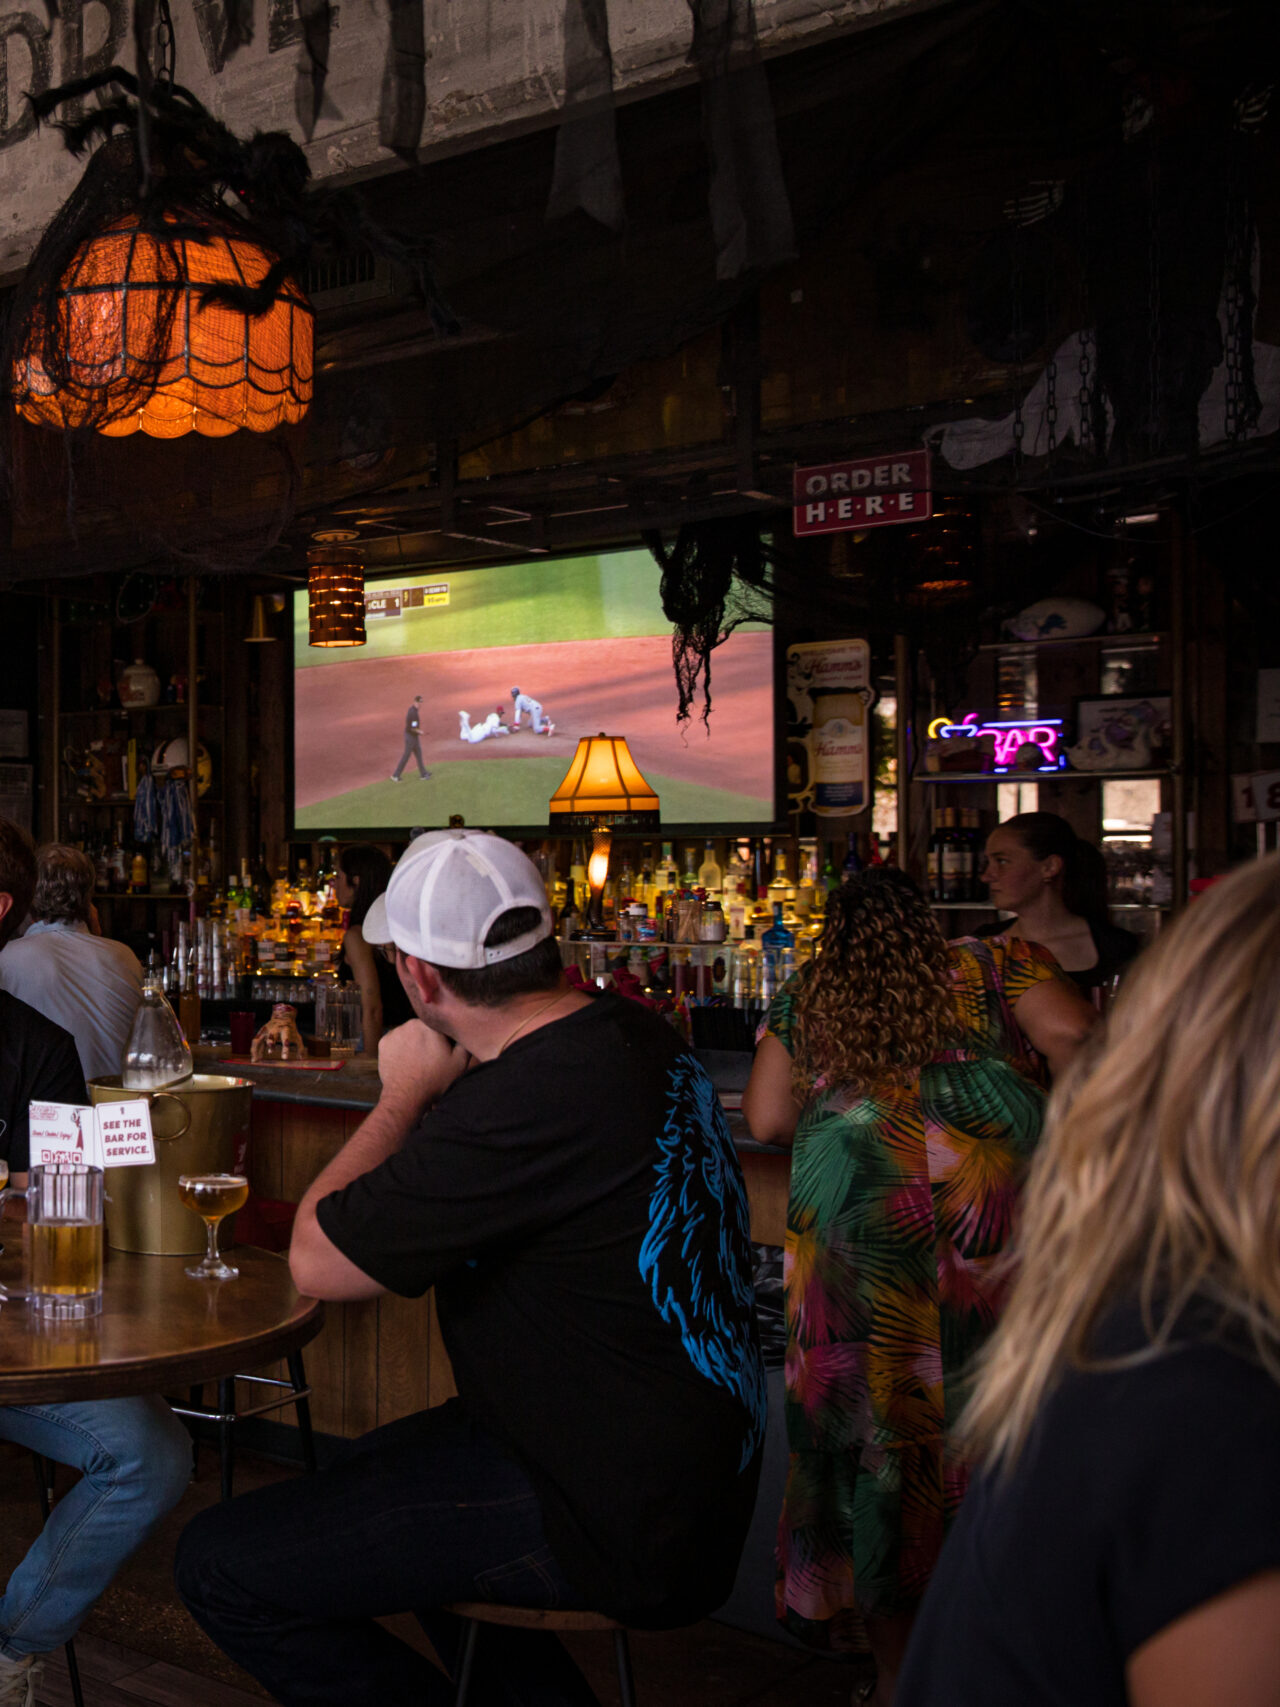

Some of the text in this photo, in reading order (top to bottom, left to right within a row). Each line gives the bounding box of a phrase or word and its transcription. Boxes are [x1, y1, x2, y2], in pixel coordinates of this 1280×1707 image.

[805, 462, 913, 496] ORDER
[103, 1118, 142, 1130] SEE THE
[104, 1131, 147, 1143] BAR FOR
[106, 1145, 150, 1157] SERVICE.
